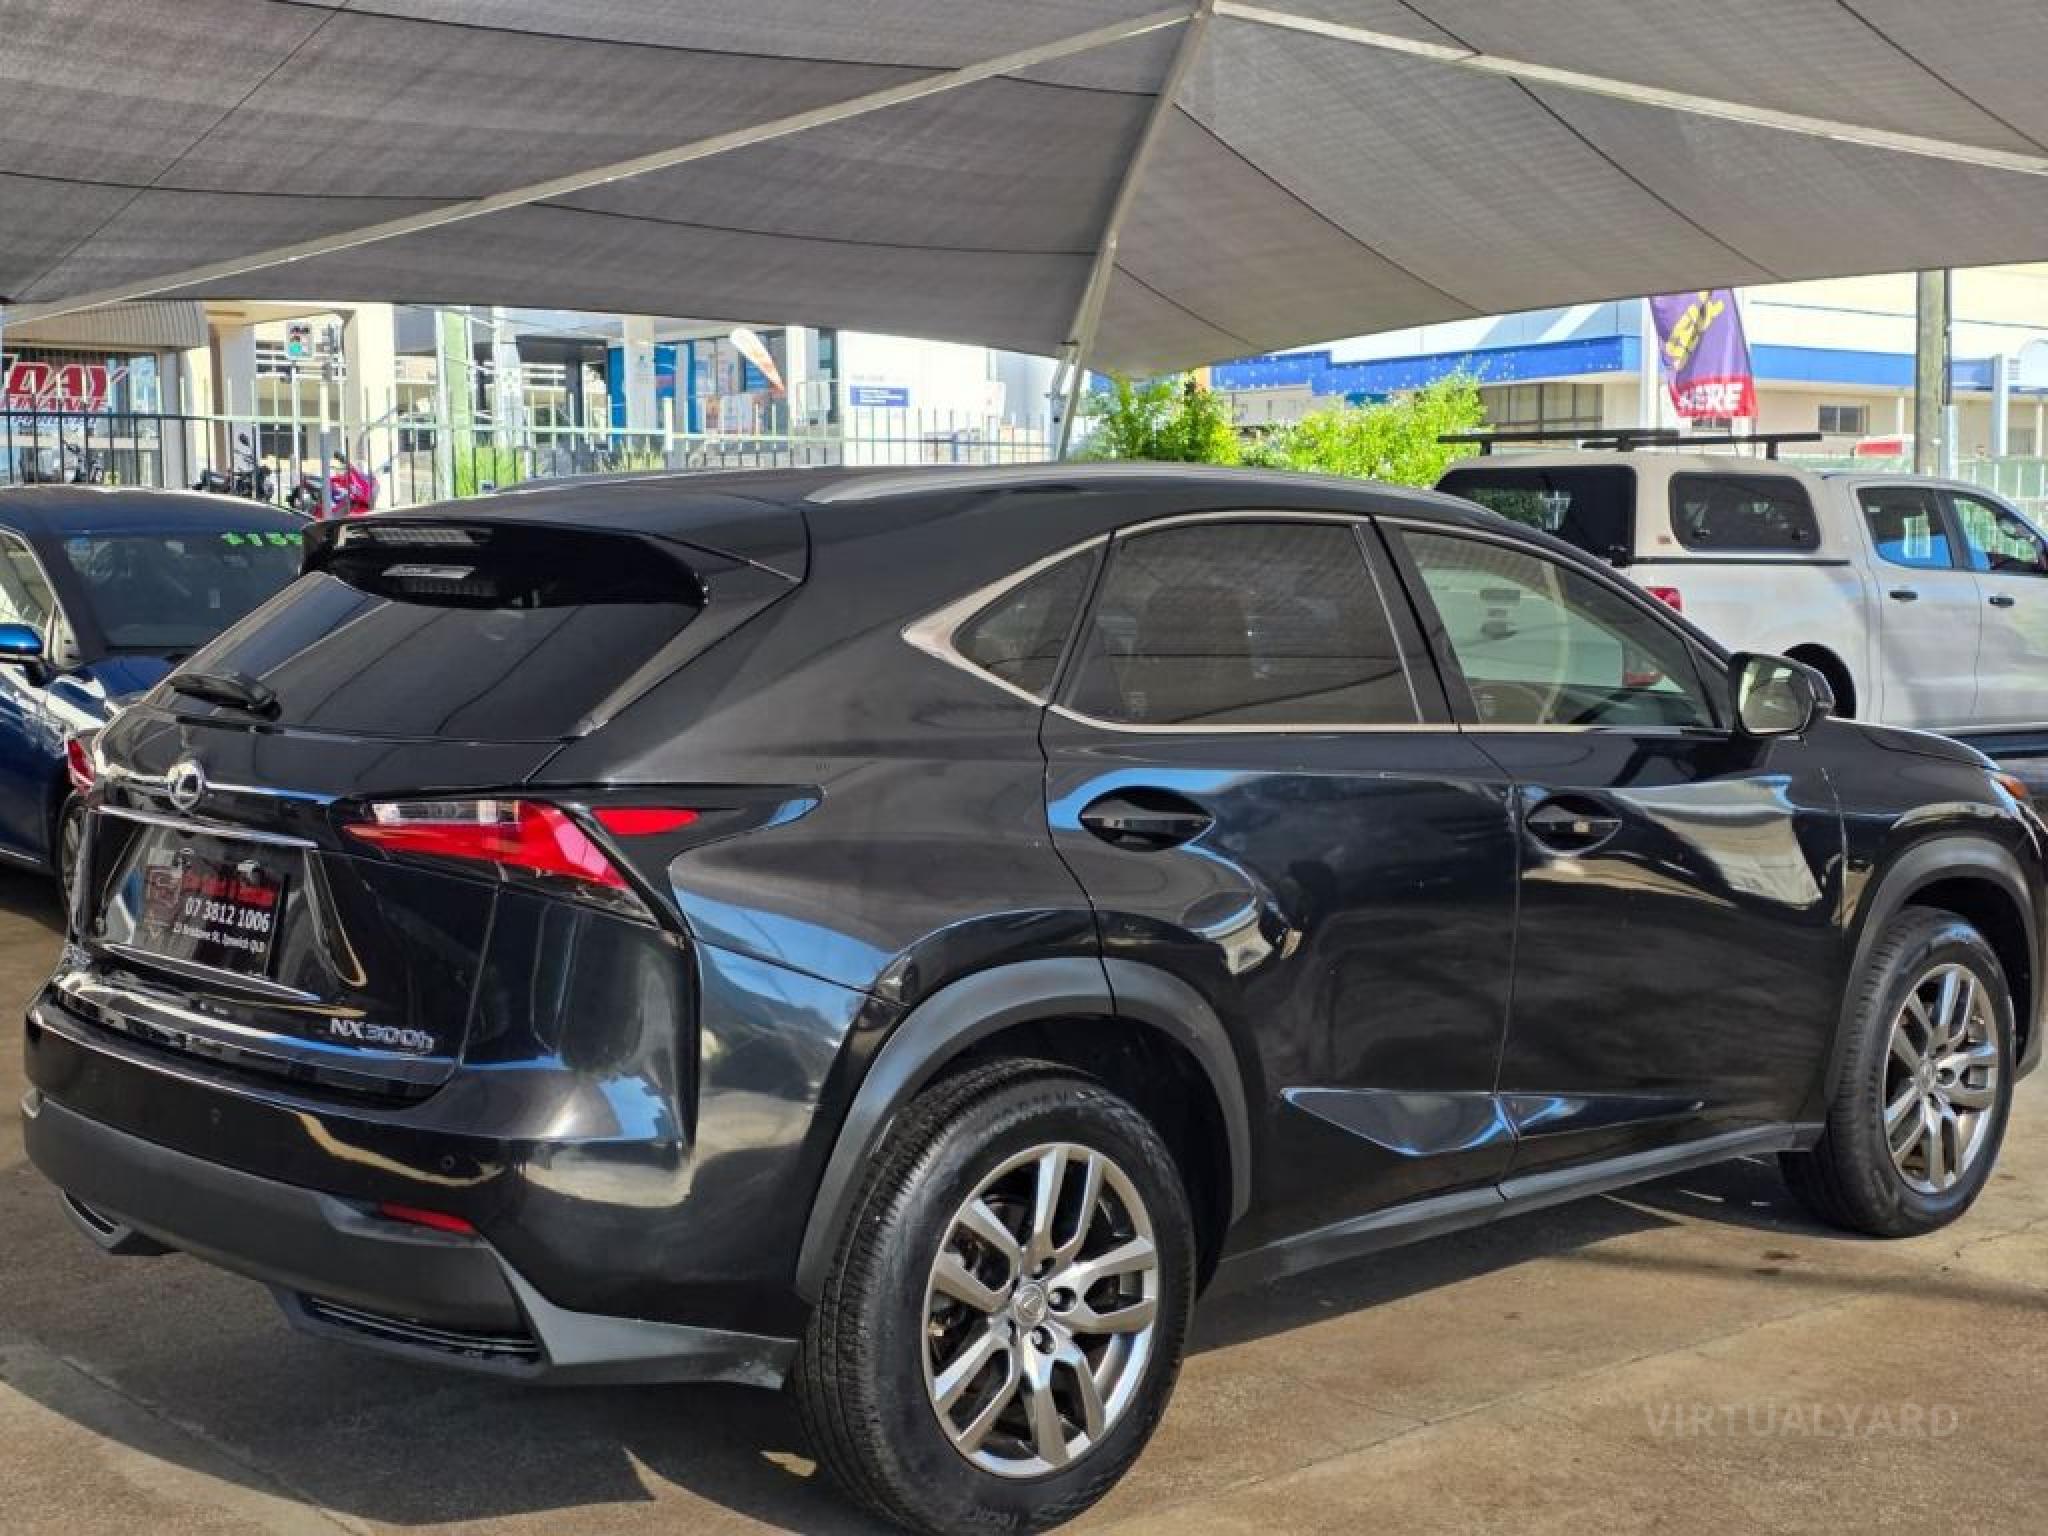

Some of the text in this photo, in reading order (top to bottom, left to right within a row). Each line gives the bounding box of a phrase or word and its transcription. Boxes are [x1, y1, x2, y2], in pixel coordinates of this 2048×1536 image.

[185, 896, 201, 917] 07
[202, 901, 236, 926] 3812
[238, 908, 272, 933] 1006
[330, 1017, 434, 1050] NX300h
